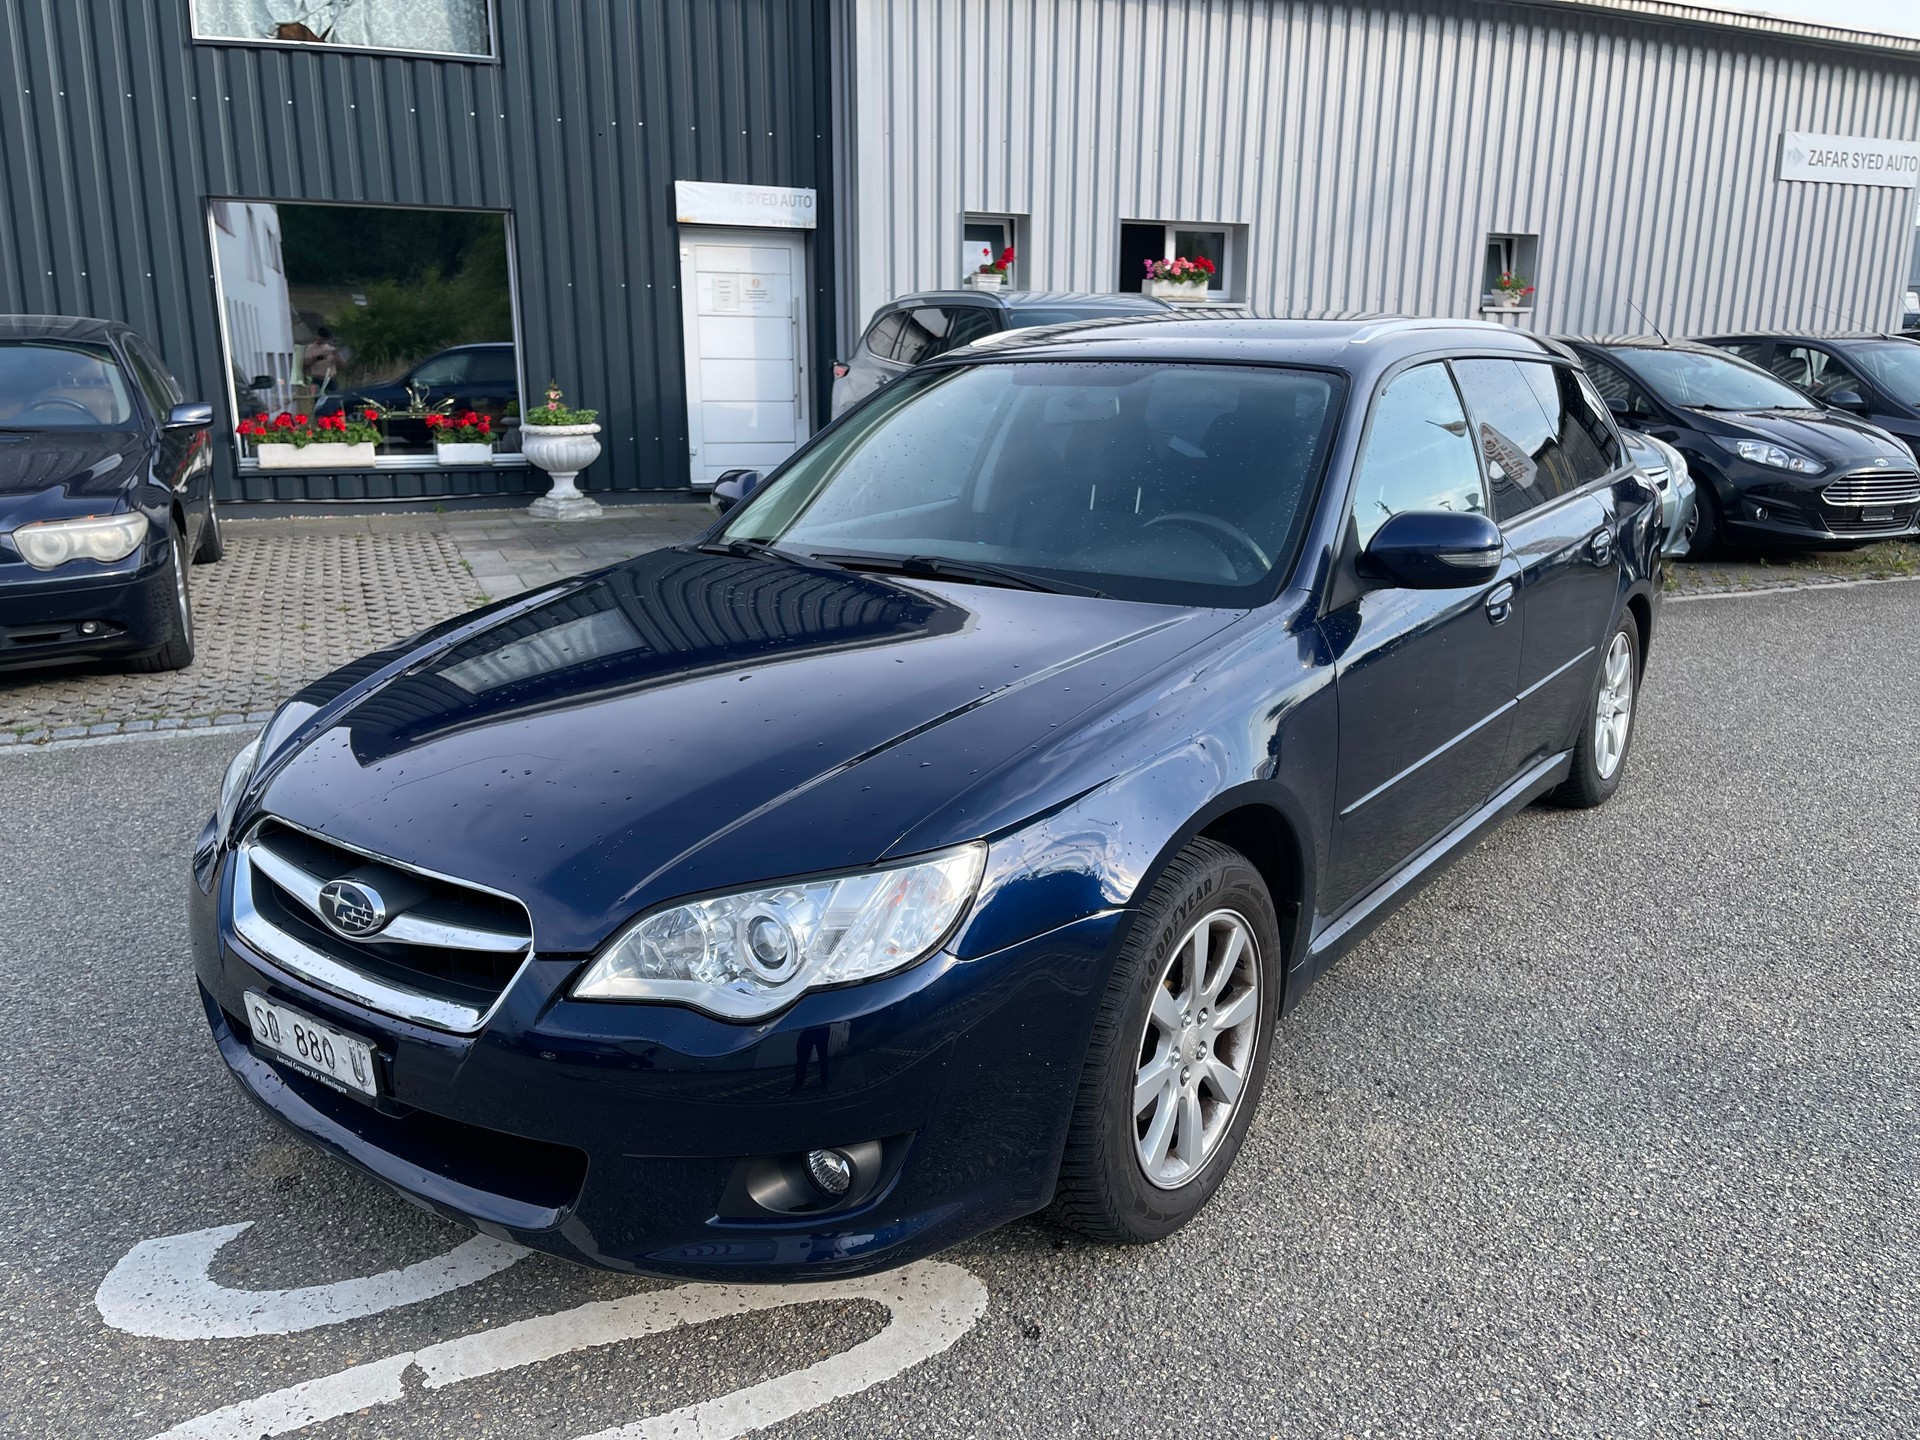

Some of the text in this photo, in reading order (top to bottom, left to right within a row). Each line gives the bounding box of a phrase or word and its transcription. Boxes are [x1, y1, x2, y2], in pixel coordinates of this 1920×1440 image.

[1808, 149, 1918, 172] ZAFAR SYED AUTO
[746, 191, 778, 207] SYED
[779, 194, 813, 209] AUTO
[1141, 878, 1213, 995] GOODYEAR
[255, 1005, 369, 1086] SO 880 U
[293, 1062, 310, 1077] Garage
[311, 1071, 319, 1080] AG
